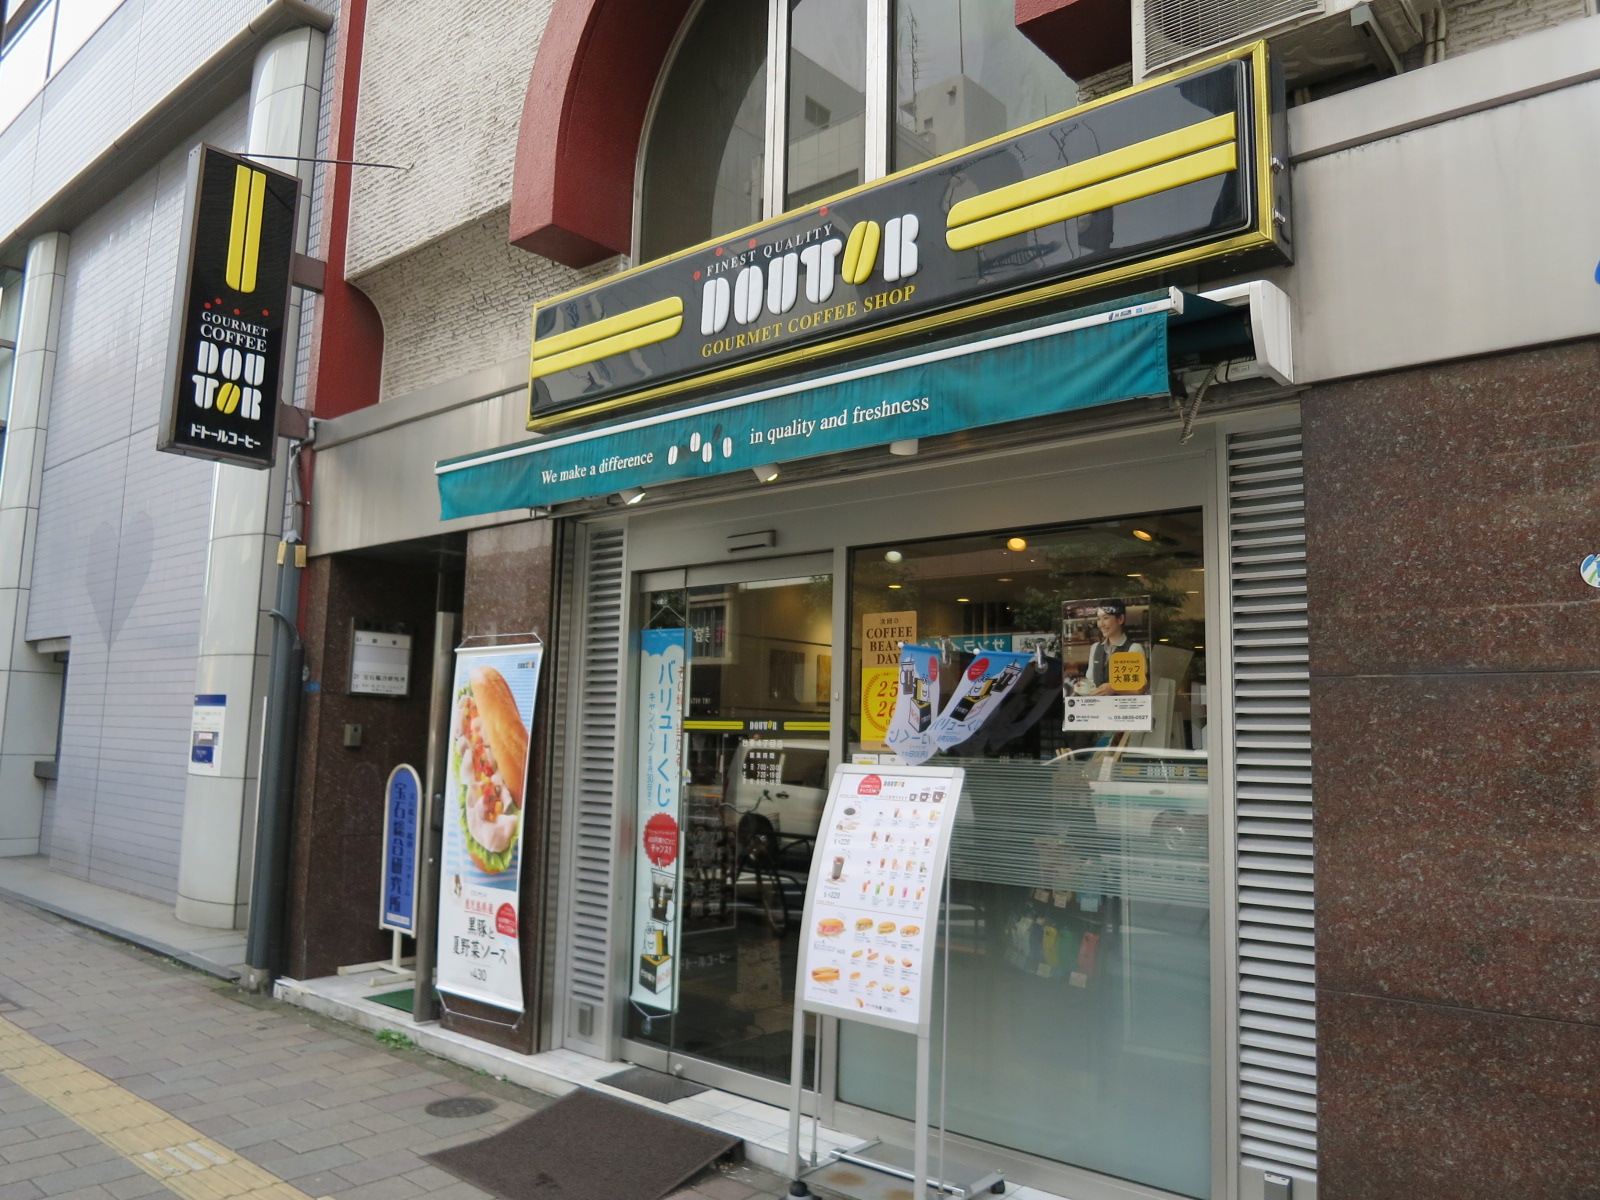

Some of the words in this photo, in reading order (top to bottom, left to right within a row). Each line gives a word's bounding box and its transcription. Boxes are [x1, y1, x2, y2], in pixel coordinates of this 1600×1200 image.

[706, 251, 756, 277] FINEST
[763, 223, 833, 258] QUALITY
[701, 213, 919, 336] DOUTOR
[200, 324, 267, 352] COFFEE
[201, 311, 269, 337] GOURMET
[702, 322, 783, 358] GOURMET
[787, 301, 857, 333] COFFEE
[863, 285, 916, 313] SHOP
[196, 341, 265, 386] DOU
[192, 374, 262, 420] TOR
[190, 423, 261, 449] ドトールコーヒー
[541, 470, 558, 484] We
[559, 464, 587, 482] make
[589, 464, 596, 476] a
[598, 452, 654, 474] difference
[749, 428, 763, 445] in
[767, 418, 816, 445] quality
[820, 409, 848, 431] and
[852, 397, 930, 424] freshness
[866, 626, 913, 639] COFFEE
[869, 640, 909, 652] BEAN
[877, 653, 901, 665] DAY
[1113, 665, 1140, 673] スタッフ
[1113, 674, 1140, 683] 大募集
[648, 693, 656, 752] キャンペーン
[657, 659, 676, 808] バリューくじ
